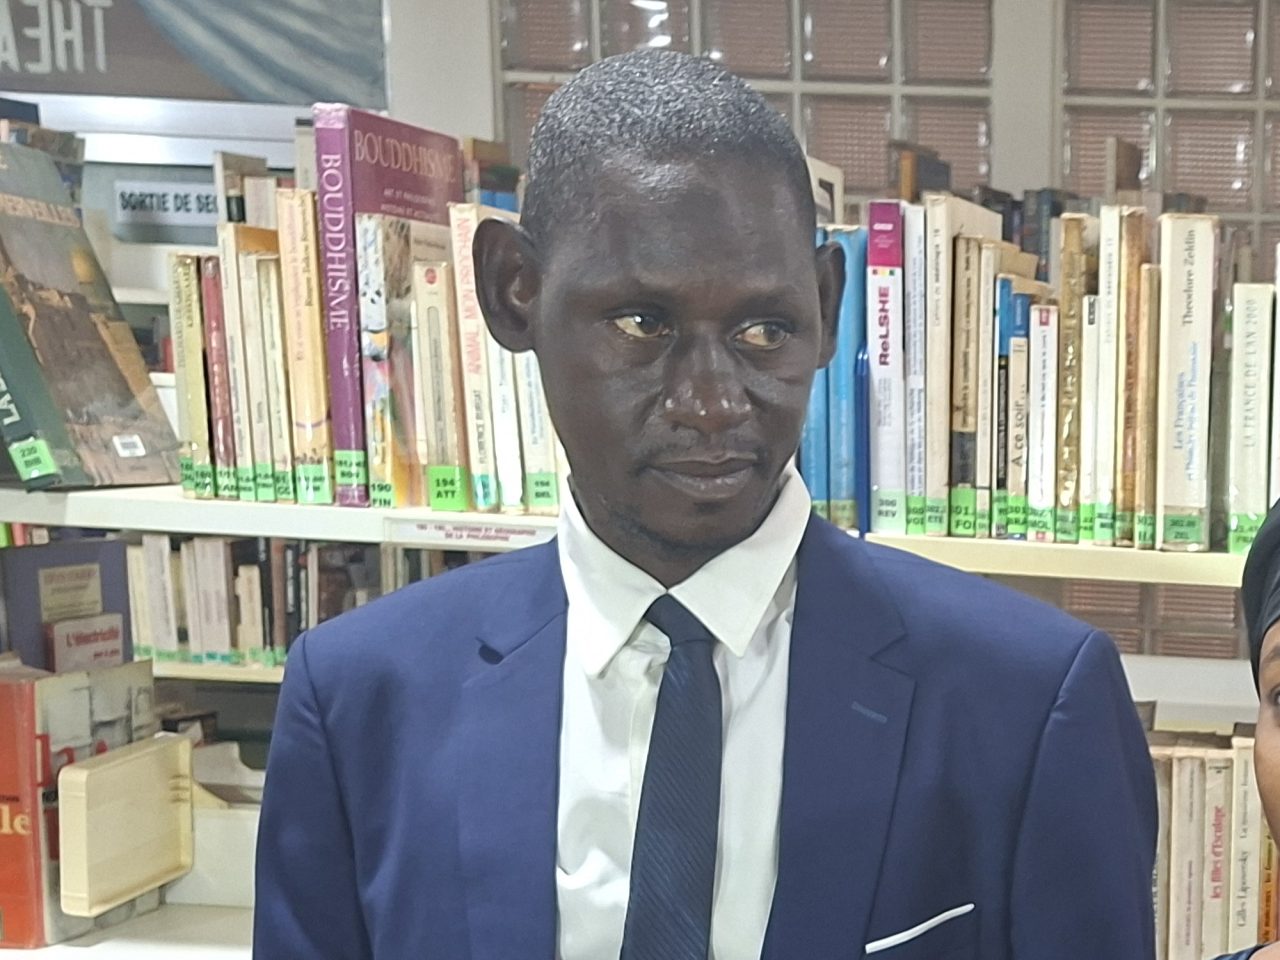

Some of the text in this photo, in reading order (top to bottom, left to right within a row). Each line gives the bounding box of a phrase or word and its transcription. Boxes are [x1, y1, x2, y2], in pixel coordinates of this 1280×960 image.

[354, 129, 456, 183] BOUDDHISME
[119, 191, 169, 212] SORTIE
[173, 193, 192, 212] DE
[320, 153, 351, 331] BOUDDHISME
[1183, 228, 1196, 267] Zeldin
[878, 286, 890, 366] ReLSHE
[1245, 360, 1257, 377] DE
[1244, 383, 1257, 429] FRANCE
[1014, 434, 1024, 450] ce
[1173, 432, 1184, 450] Les
[1244, 434, 1256, 448] LA
[1011, 454, 1024, 467] A
[371, 483, 392, 493] 190
[435, 478, 456, 488] 194
[436, 490, 456, 500] ATT
[877, 509, 897, 519] REV
[1236, 901, 1248, 928] Gilles
